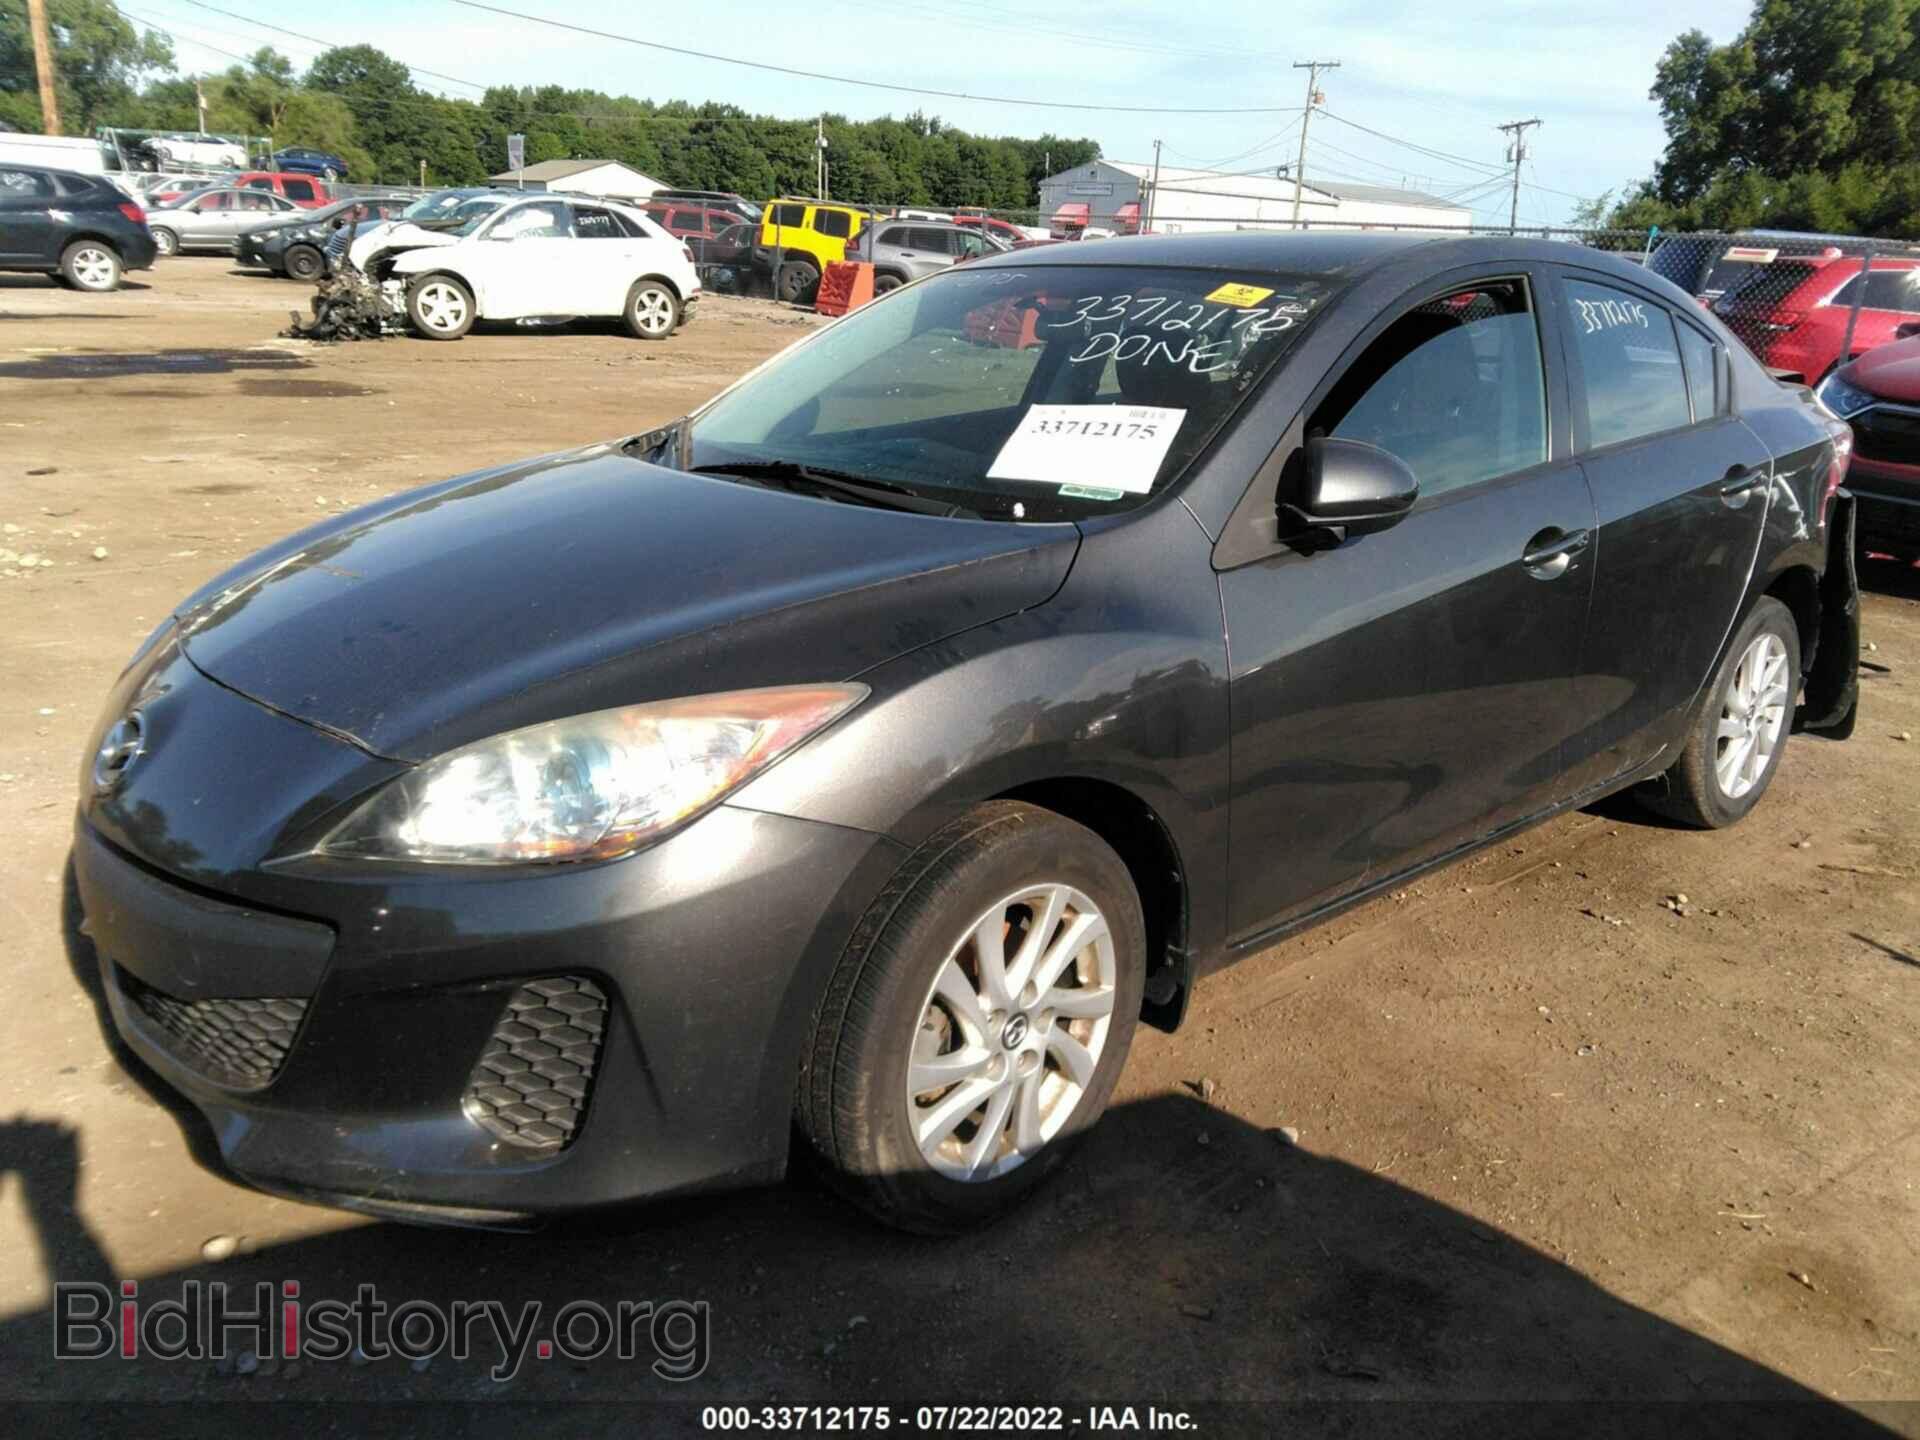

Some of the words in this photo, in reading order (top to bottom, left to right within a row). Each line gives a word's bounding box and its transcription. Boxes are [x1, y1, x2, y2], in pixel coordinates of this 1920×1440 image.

[1048, 294, 1308, 332] 33712175
[1575, 298, 1649, 334] 33712175
[1069, 332, 1233, 373] DONE
[1031, 420, 1158, 440] 33712175
